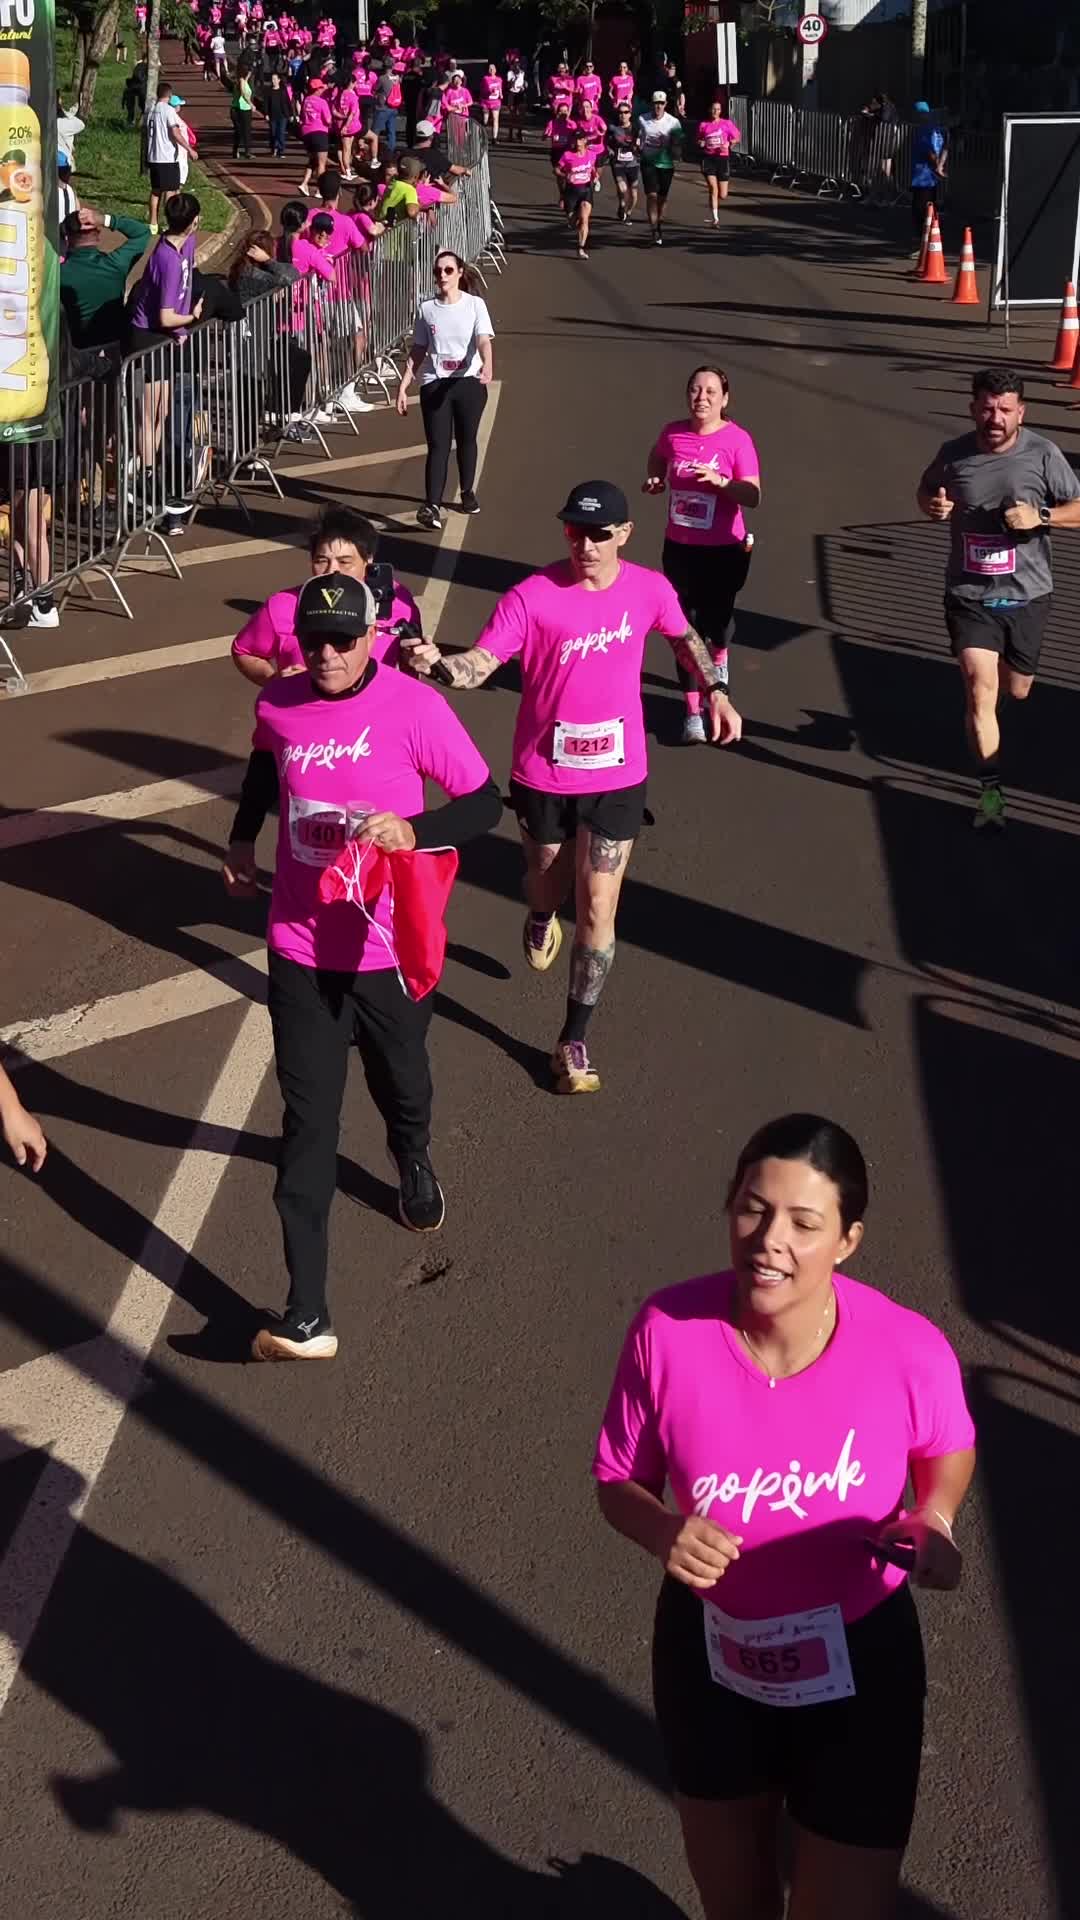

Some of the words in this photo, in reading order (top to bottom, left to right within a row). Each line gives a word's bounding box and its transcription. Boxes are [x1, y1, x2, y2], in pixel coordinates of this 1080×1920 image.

[802, 19, 821, 32] 40
[8, 125, 33, 140] 20%
[559, 610, 633, 665] gopink
[281, 725, 372, 777] gopink
[571, 737, 609, 753] 1212
[692, 1427, 867, 1524] gopink
[739, 1647, 801, 1675] 665
